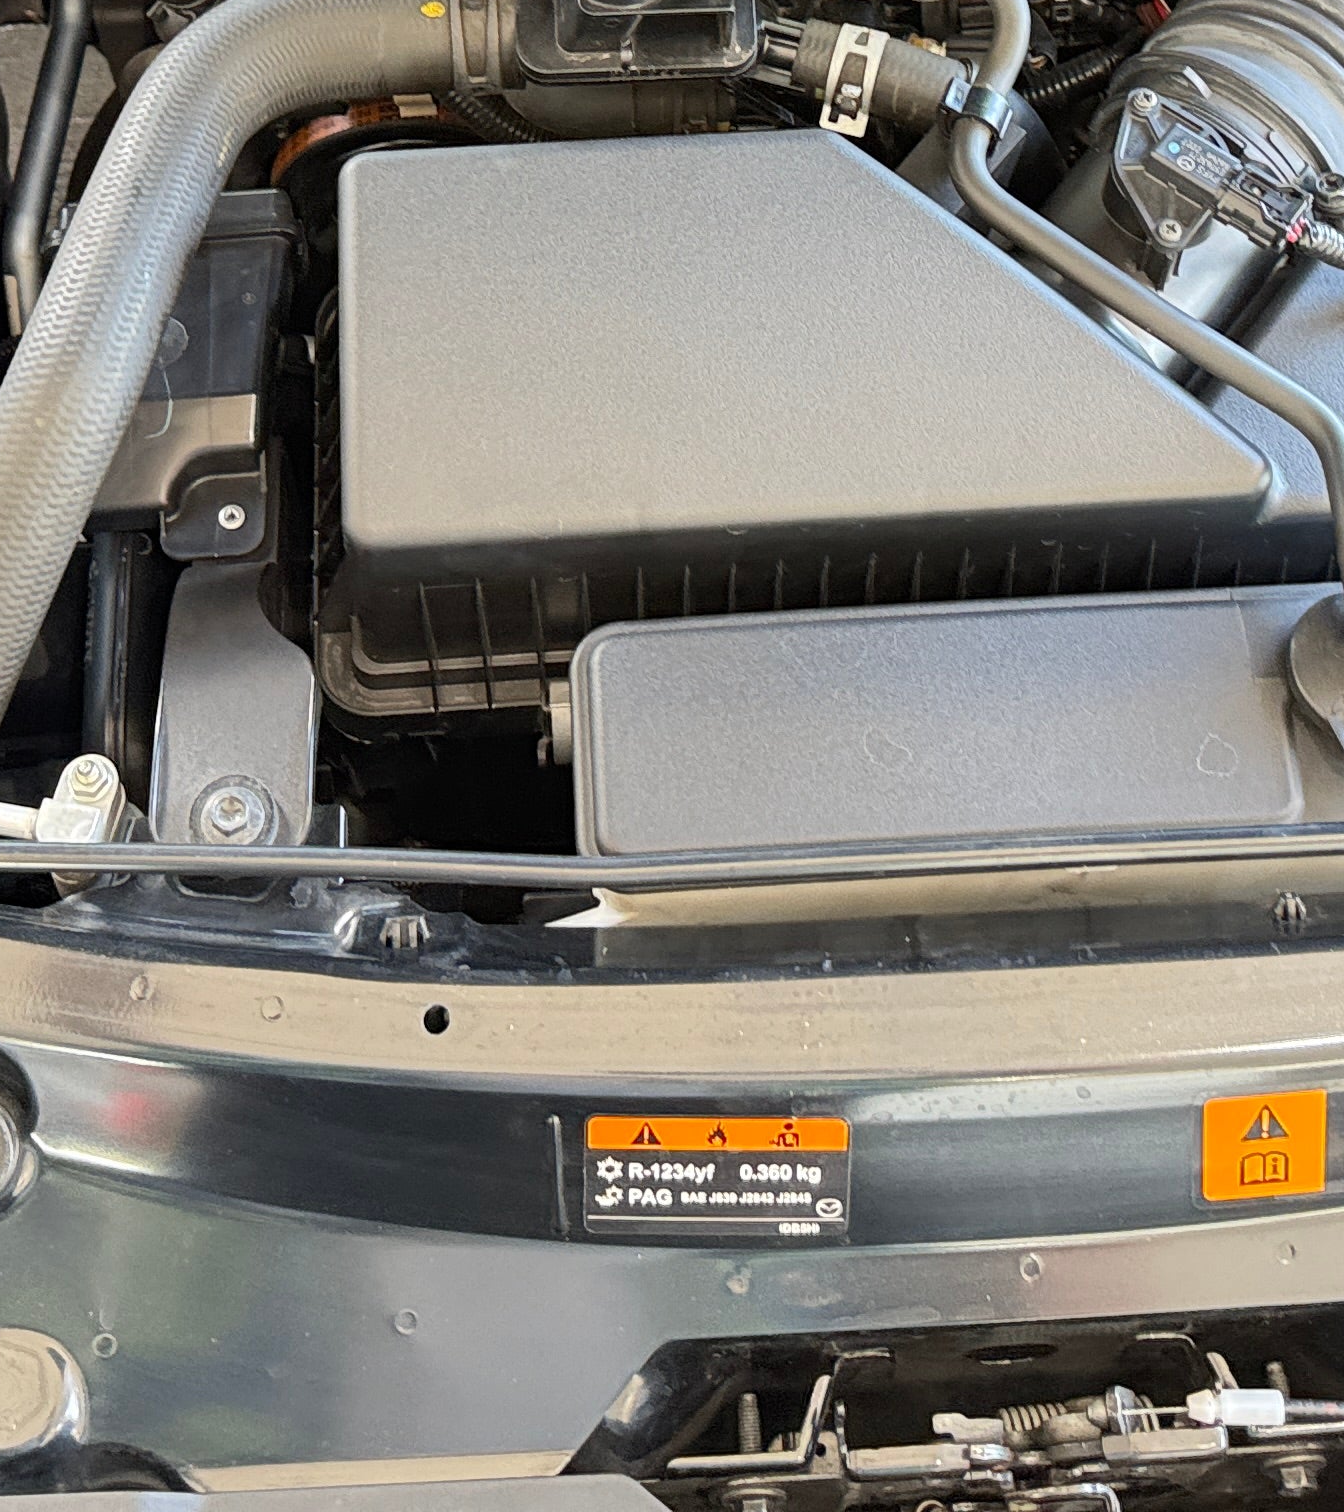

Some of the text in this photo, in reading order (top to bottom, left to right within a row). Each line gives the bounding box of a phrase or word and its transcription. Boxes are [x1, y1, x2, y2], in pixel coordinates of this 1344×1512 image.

[627, 1162, 823, 1185] R-1234yf 0.360 kg
[628, 1187, 674, 1207] PAG
